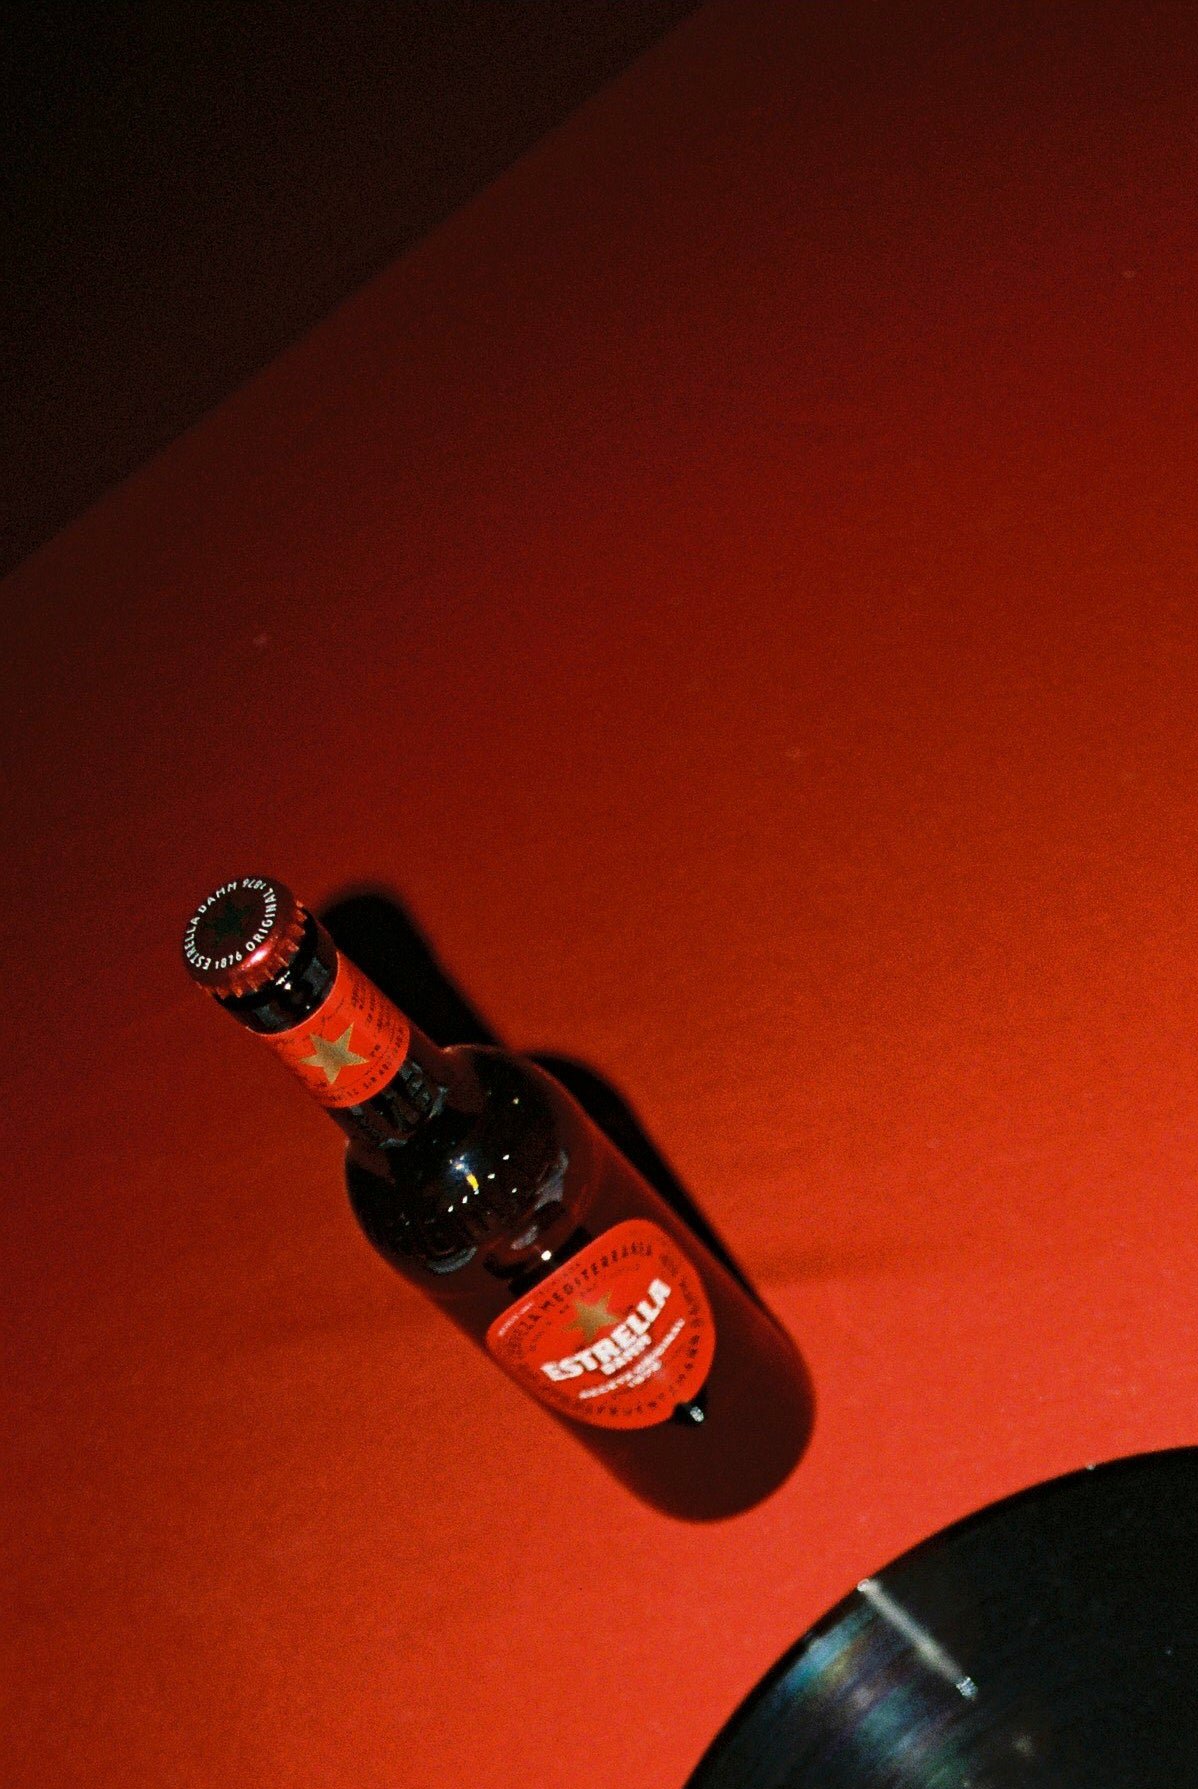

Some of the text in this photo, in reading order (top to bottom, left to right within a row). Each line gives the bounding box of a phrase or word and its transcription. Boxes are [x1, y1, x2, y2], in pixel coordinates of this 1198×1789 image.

[183, 881, 237, 970] ESTRELLA DAMM
[214, 950, 242, 969] 1876
[245, 887, 276, 952] ORIGINAL
[539, 1277, 672, 1383] ESTRELLA
